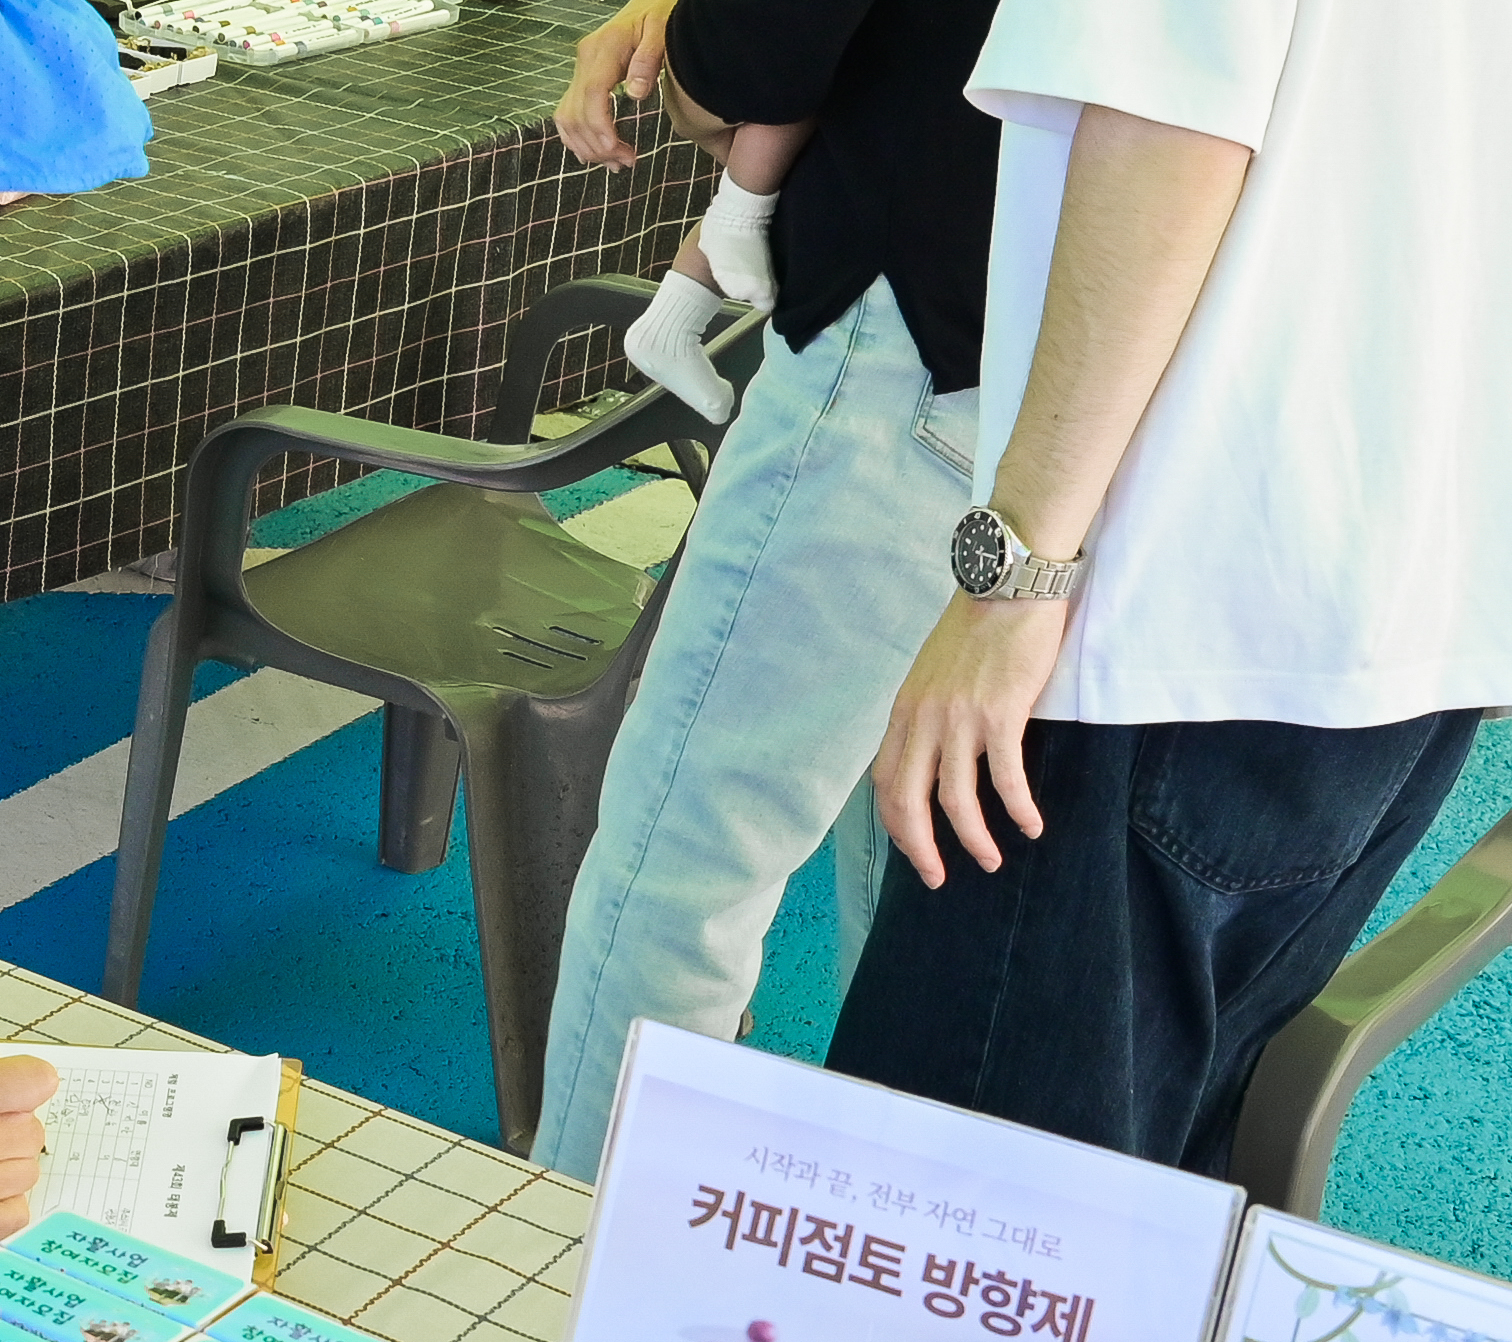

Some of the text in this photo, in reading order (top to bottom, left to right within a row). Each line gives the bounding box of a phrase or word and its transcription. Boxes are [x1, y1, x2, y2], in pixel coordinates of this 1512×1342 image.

[688, 1184, 906, 1298] 커피점토
[744, 1145, 1064, 1261] 시작과 끝, 전부 자연 그대로
[66, 1230, 148, 1268] 자활사업
[4, 1269, 86, 1309] 자활사업
